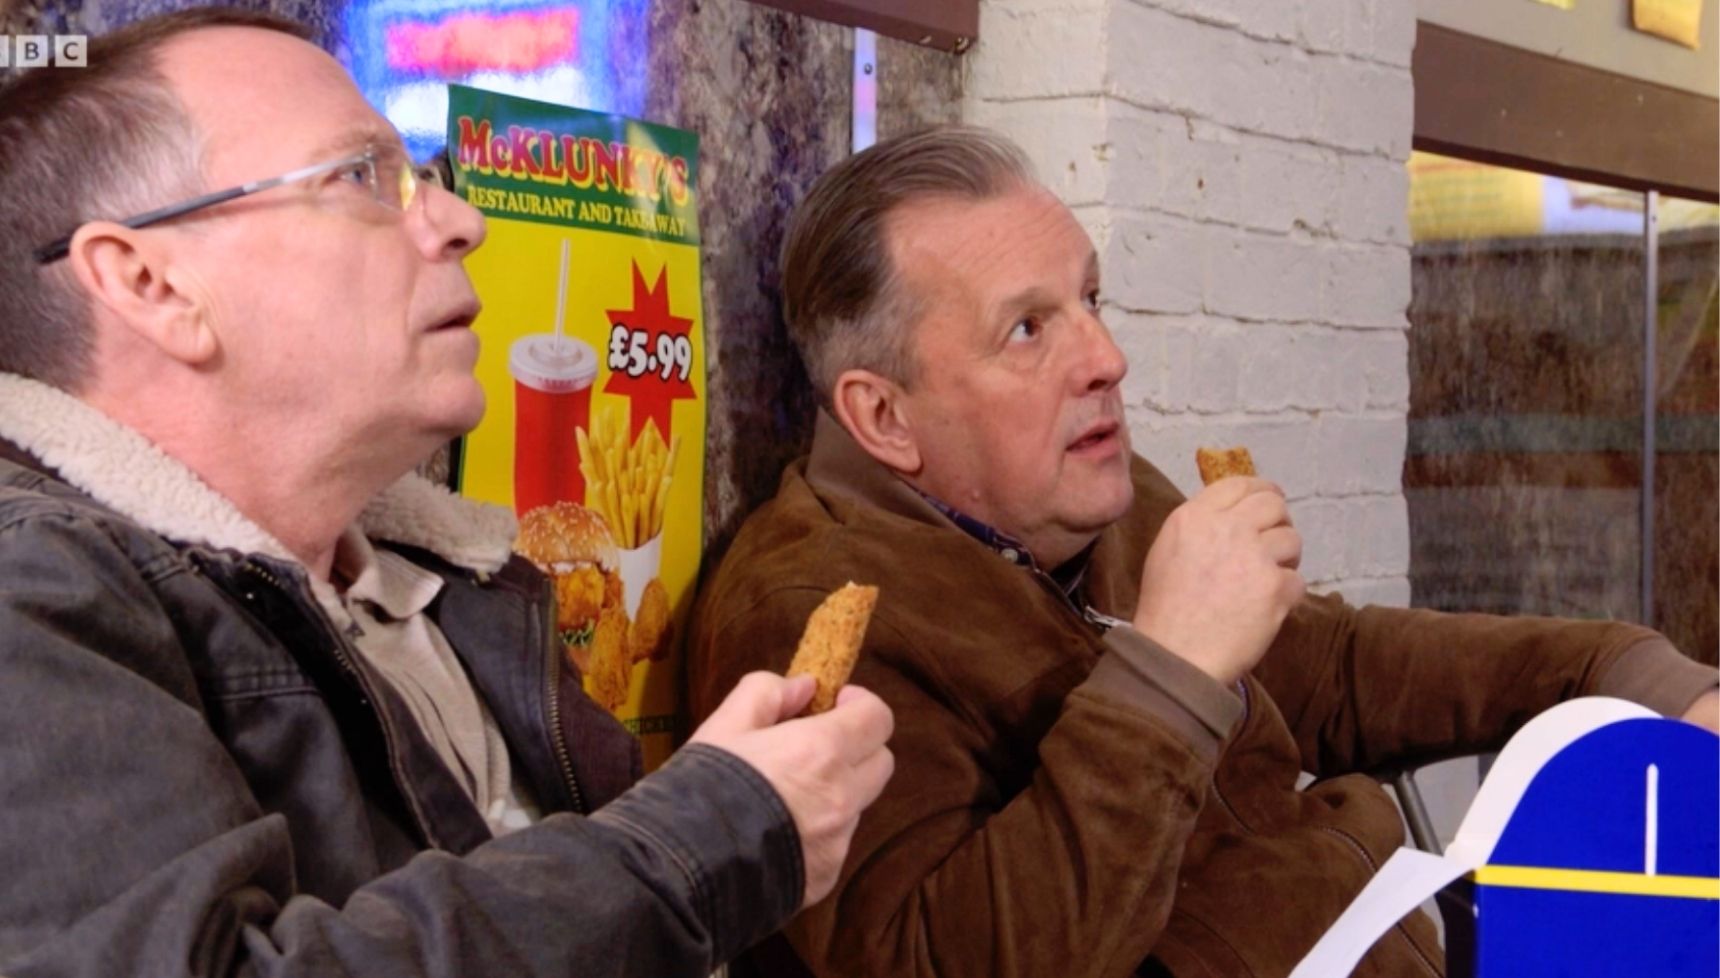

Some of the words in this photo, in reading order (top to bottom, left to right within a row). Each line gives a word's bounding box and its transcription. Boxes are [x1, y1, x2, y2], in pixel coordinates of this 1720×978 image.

[467, 185, 575, 219] RESTAURANT
[578, 201, 611, 224] AND
[614, 206, 686, 236] TAKEAWAY
[608, 323, 692, 382] £5.99
